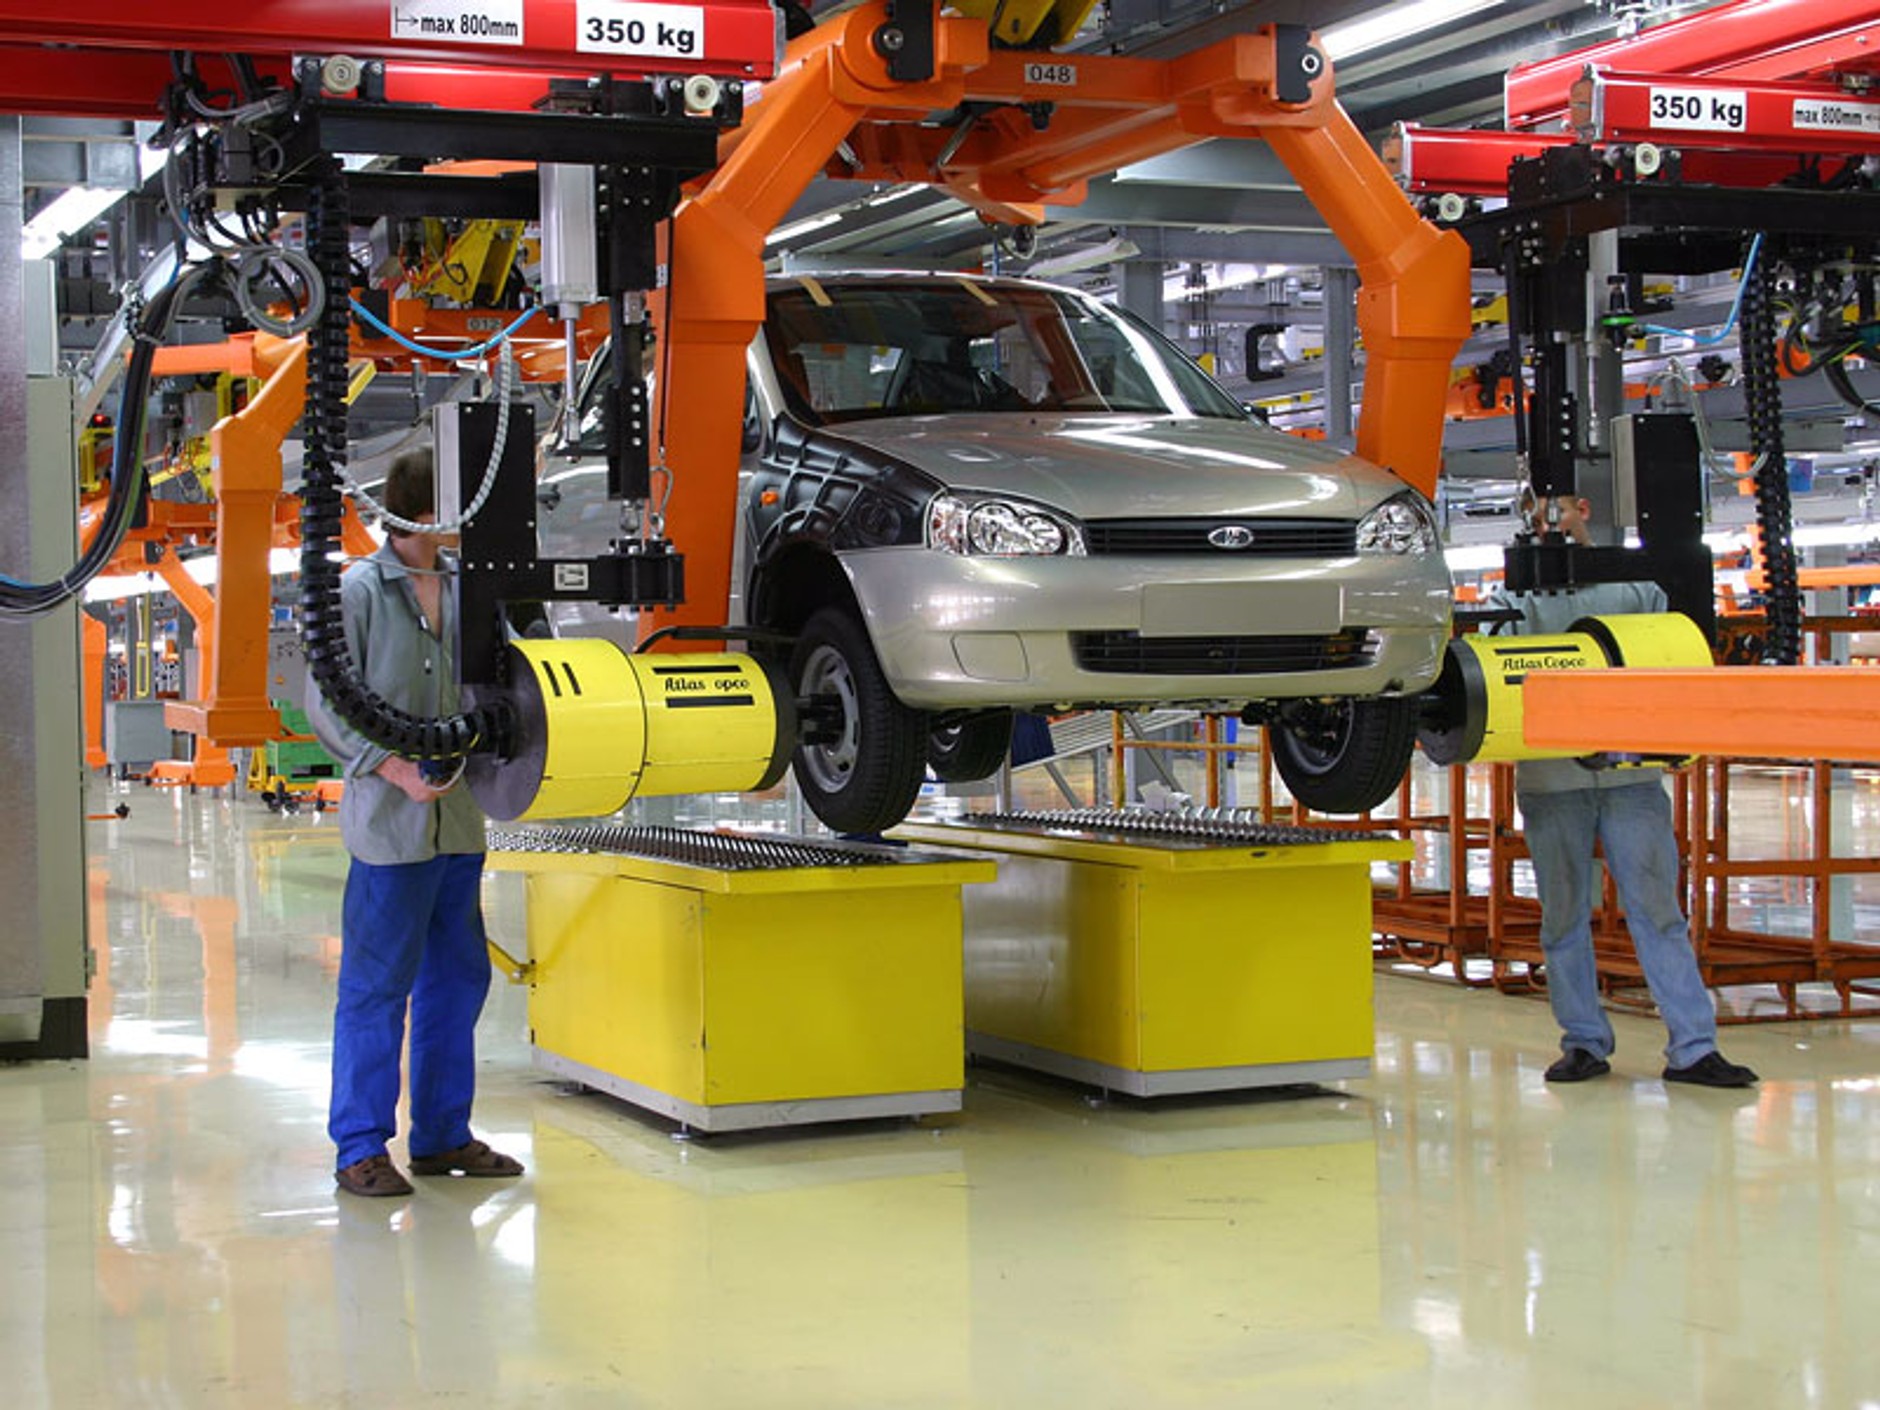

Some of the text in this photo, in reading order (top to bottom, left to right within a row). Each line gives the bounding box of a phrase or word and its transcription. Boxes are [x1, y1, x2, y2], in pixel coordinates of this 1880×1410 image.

[420, 14, 518, 37] max 800mm
[586, 17, 695, 53] 350 kg
[1030, 65, 1070, 83] 048
[1653, 95, 1743, 128] 350 kg
[1795, 106, 1862, 125] max 800mm
[1503, 656, 1586, 671] Atlas Copco
[665, 677, 706, 692] Atlas
